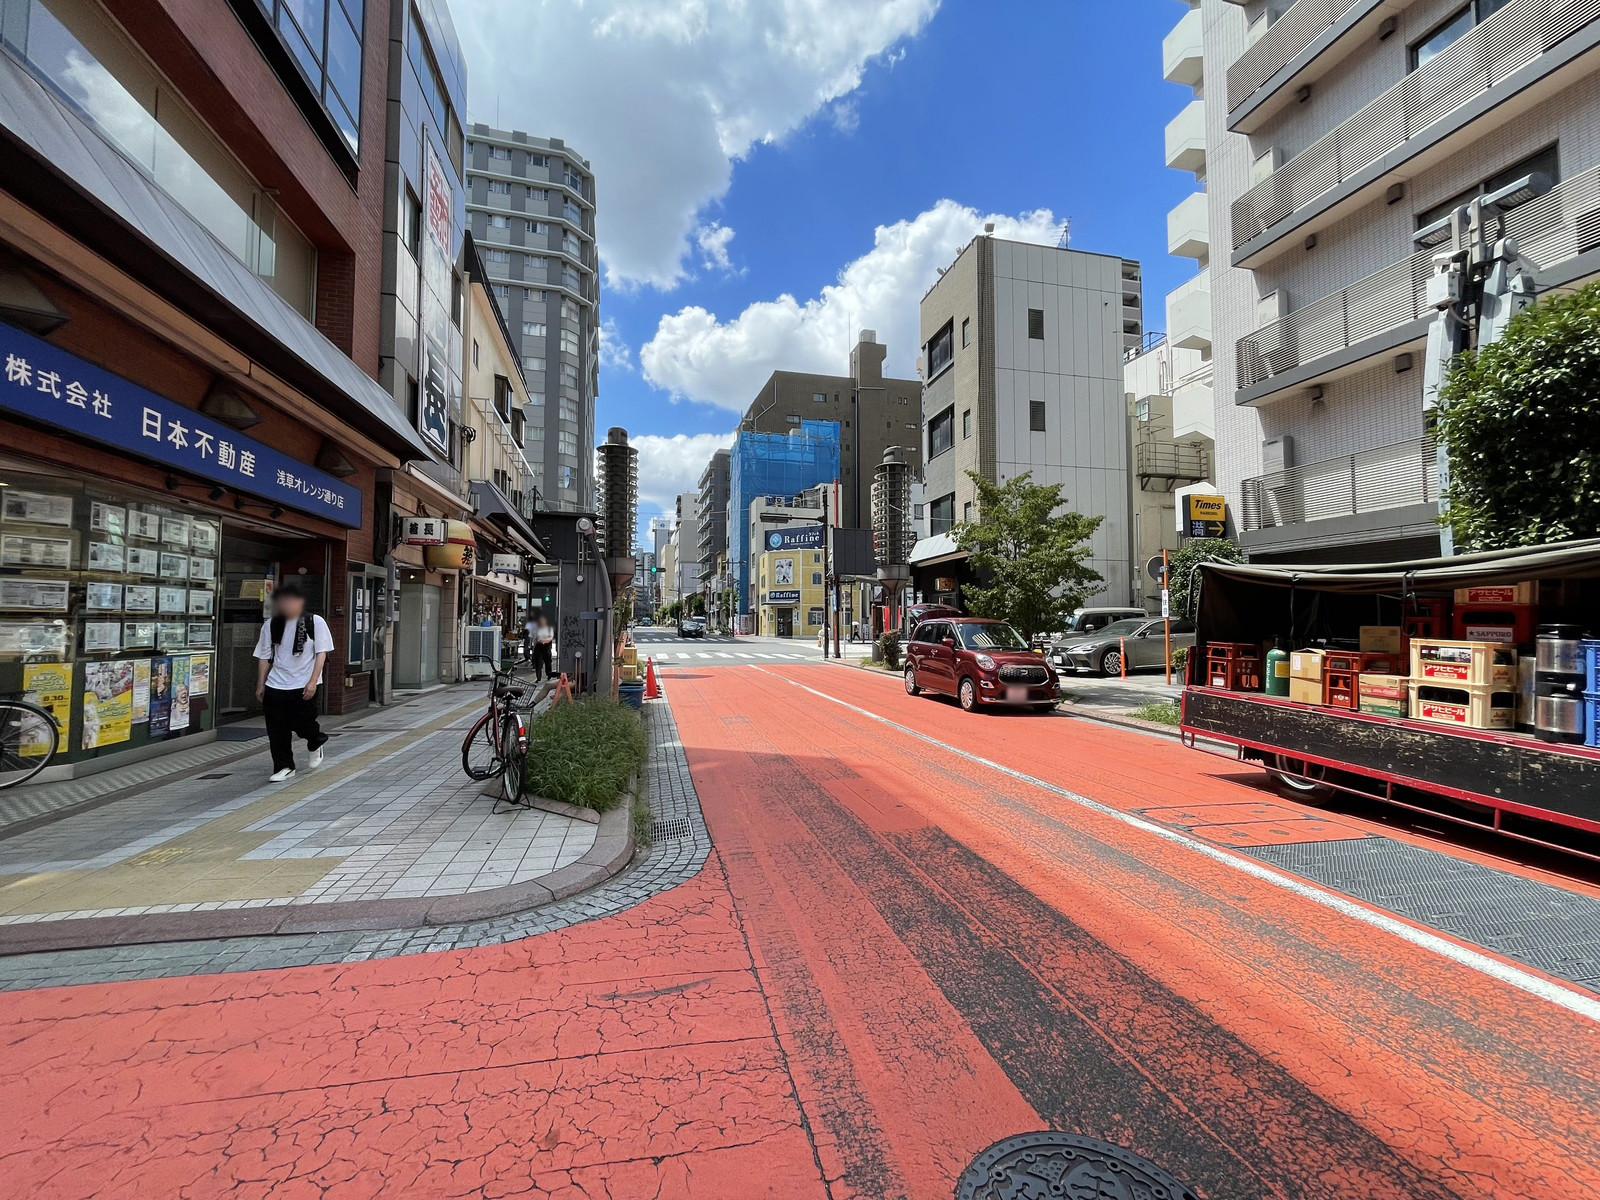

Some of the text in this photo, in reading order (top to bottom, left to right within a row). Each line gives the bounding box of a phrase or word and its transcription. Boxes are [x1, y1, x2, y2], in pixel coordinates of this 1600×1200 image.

[5, 353, 345, 509] 株式会社 日本不動産 浅草オレンジ通り店
[1195, 499, 1222, 510] Times
[784, 534, 820, 544] Raffine
[1469, 589, 1513, 597] アサヒビール
[1475, 630, 1512, 638] SAPPORO
[1425, 664, 1468, 674] アサヒビール
[1423, 704, 1466, 715] アサヒビール
